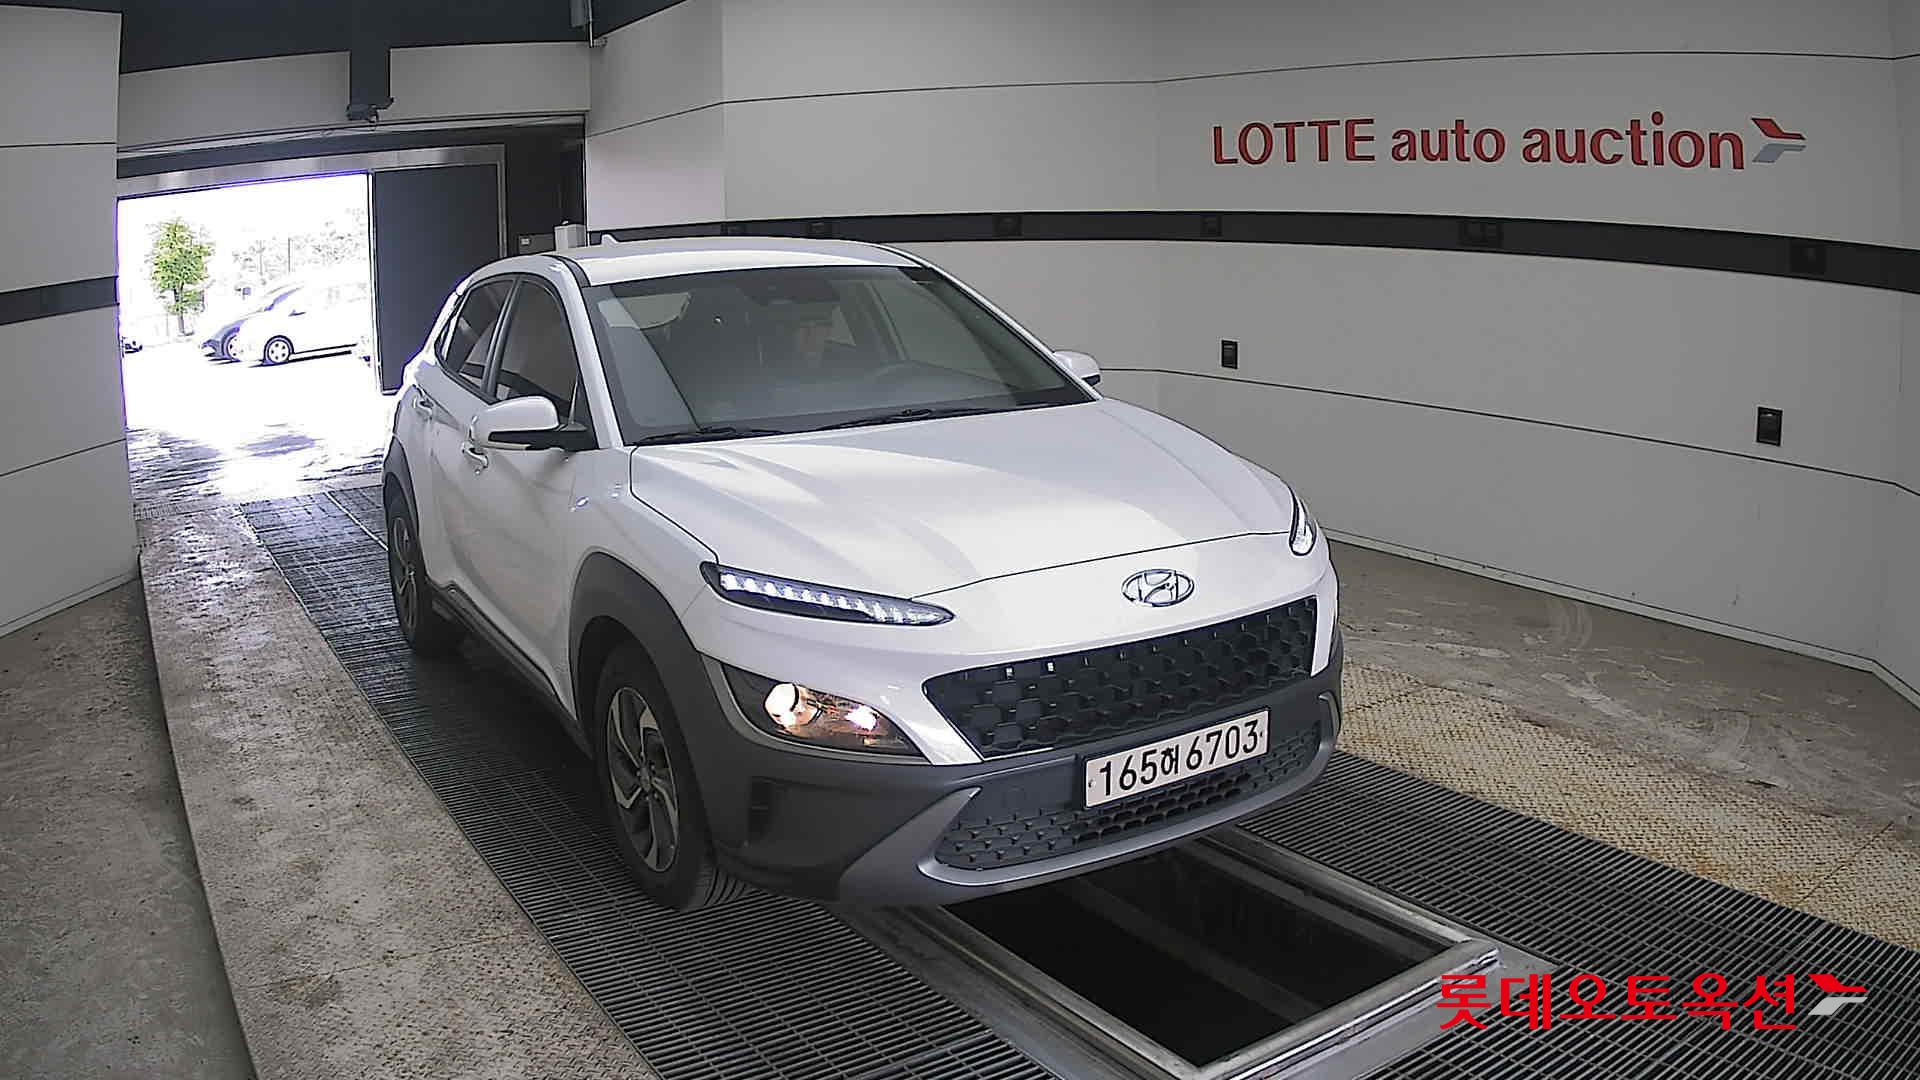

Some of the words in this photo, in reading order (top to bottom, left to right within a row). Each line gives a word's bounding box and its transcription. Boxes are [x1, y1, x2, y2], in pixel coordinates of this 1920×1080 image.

[1213, 117, 1376, 165] LOTTE
[1391, 118, 1505, 163] auto
[1521, 110, 1745, 169] auction
